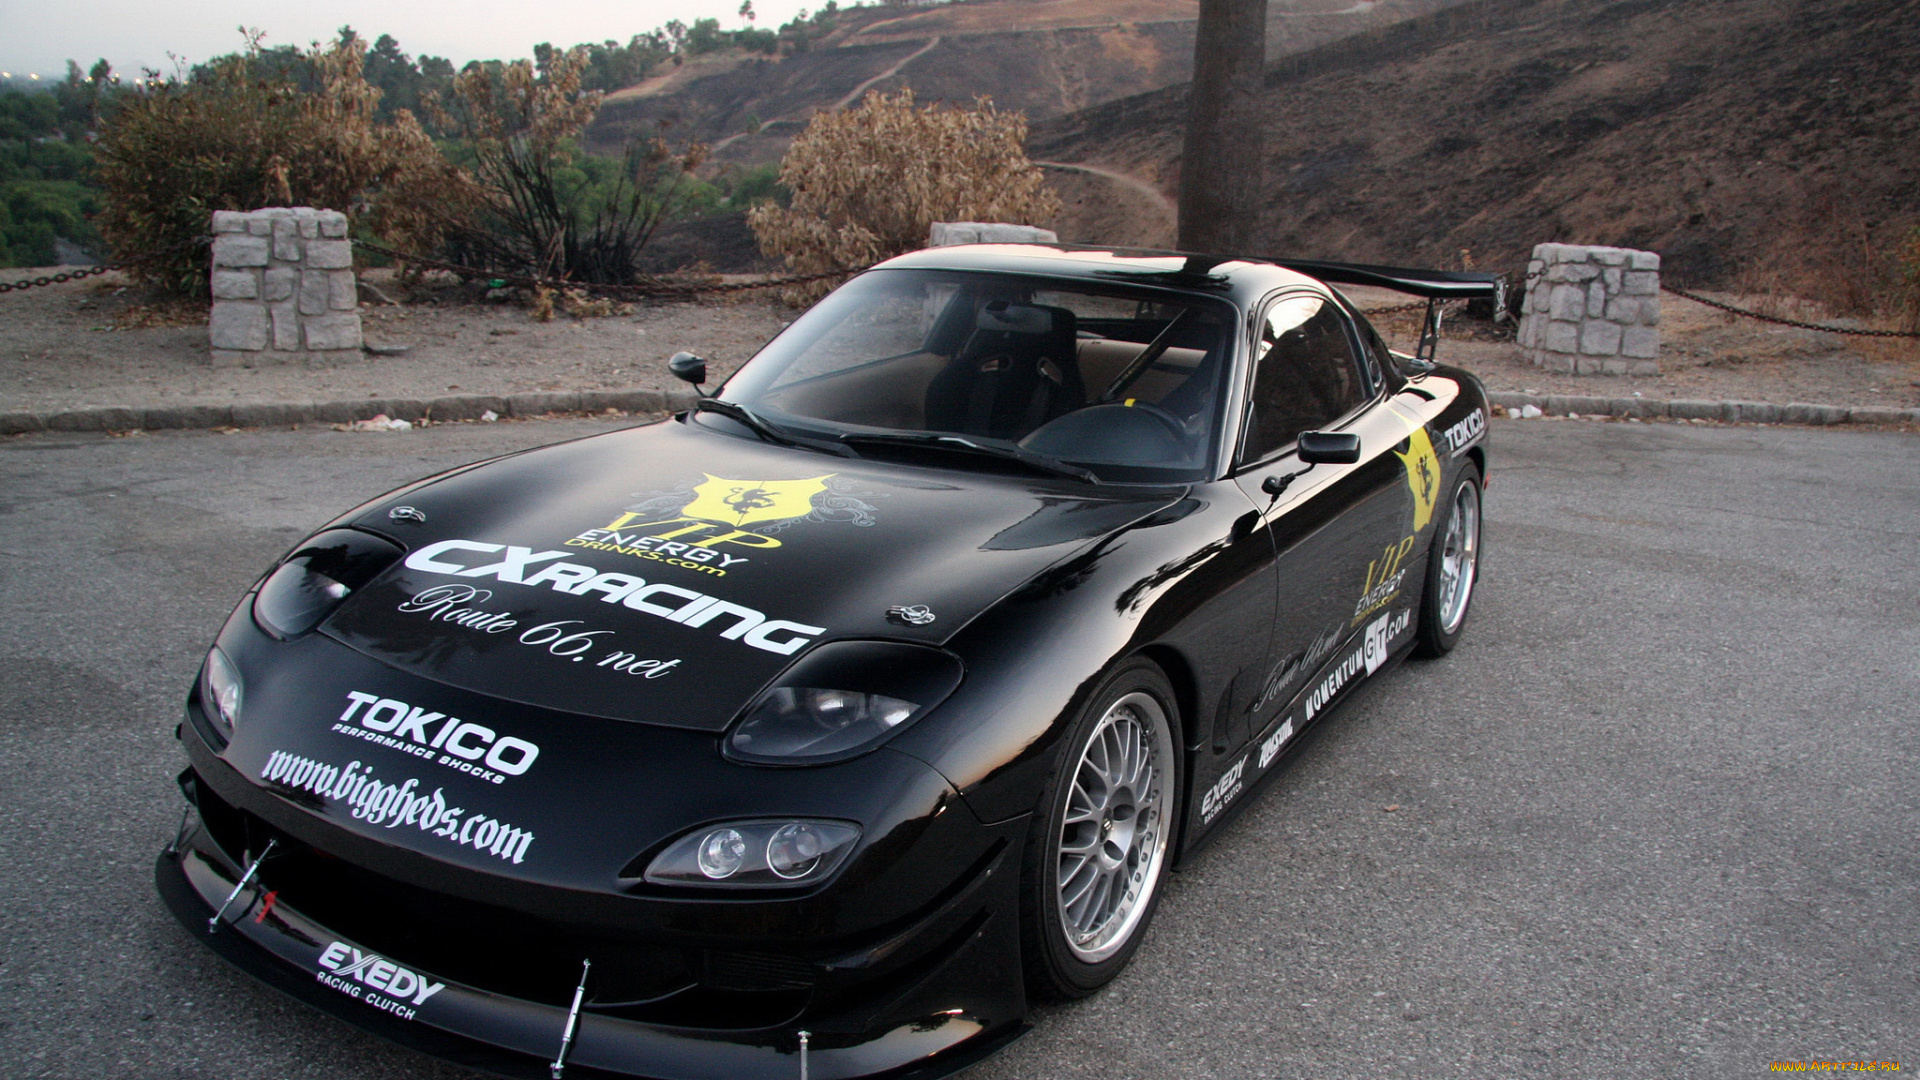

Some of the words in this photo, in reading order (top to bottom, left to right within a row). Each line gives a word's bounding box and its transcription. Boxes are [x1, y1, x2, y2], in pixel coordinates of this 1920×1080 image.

[1444, 407, 1485, 451] TOKICO
[576, 529, 749, 567] ENERGY
[599, 512, 782, 548] VIP
[564, 539, 727, 577] DRINKS.com
[1363, 535, 1414, 596] VIP
[397, 583, 519, 635] Route
[404, 539, 827, 655] CXRACING
[1355, 569, 1406, 616] ENERGY
[332, 723, 434, 760] PERFORMANCE
[438, 755, 506, 785] SHOCKS
[338, 690, 540, 777] TOKICO
[261, 749, 535, 865] www.biggheds.com
[1201, 754, 1248, 816] EXEDY
[1204, 801, 1223, 825] RACING
[1224, 780, 1243, 804] CLUTCH
[317, 971, 360, 999] RACING
[365, 993, 417, 1021] CLUTCH
[318, 941, 445, 1006] EXEDY
